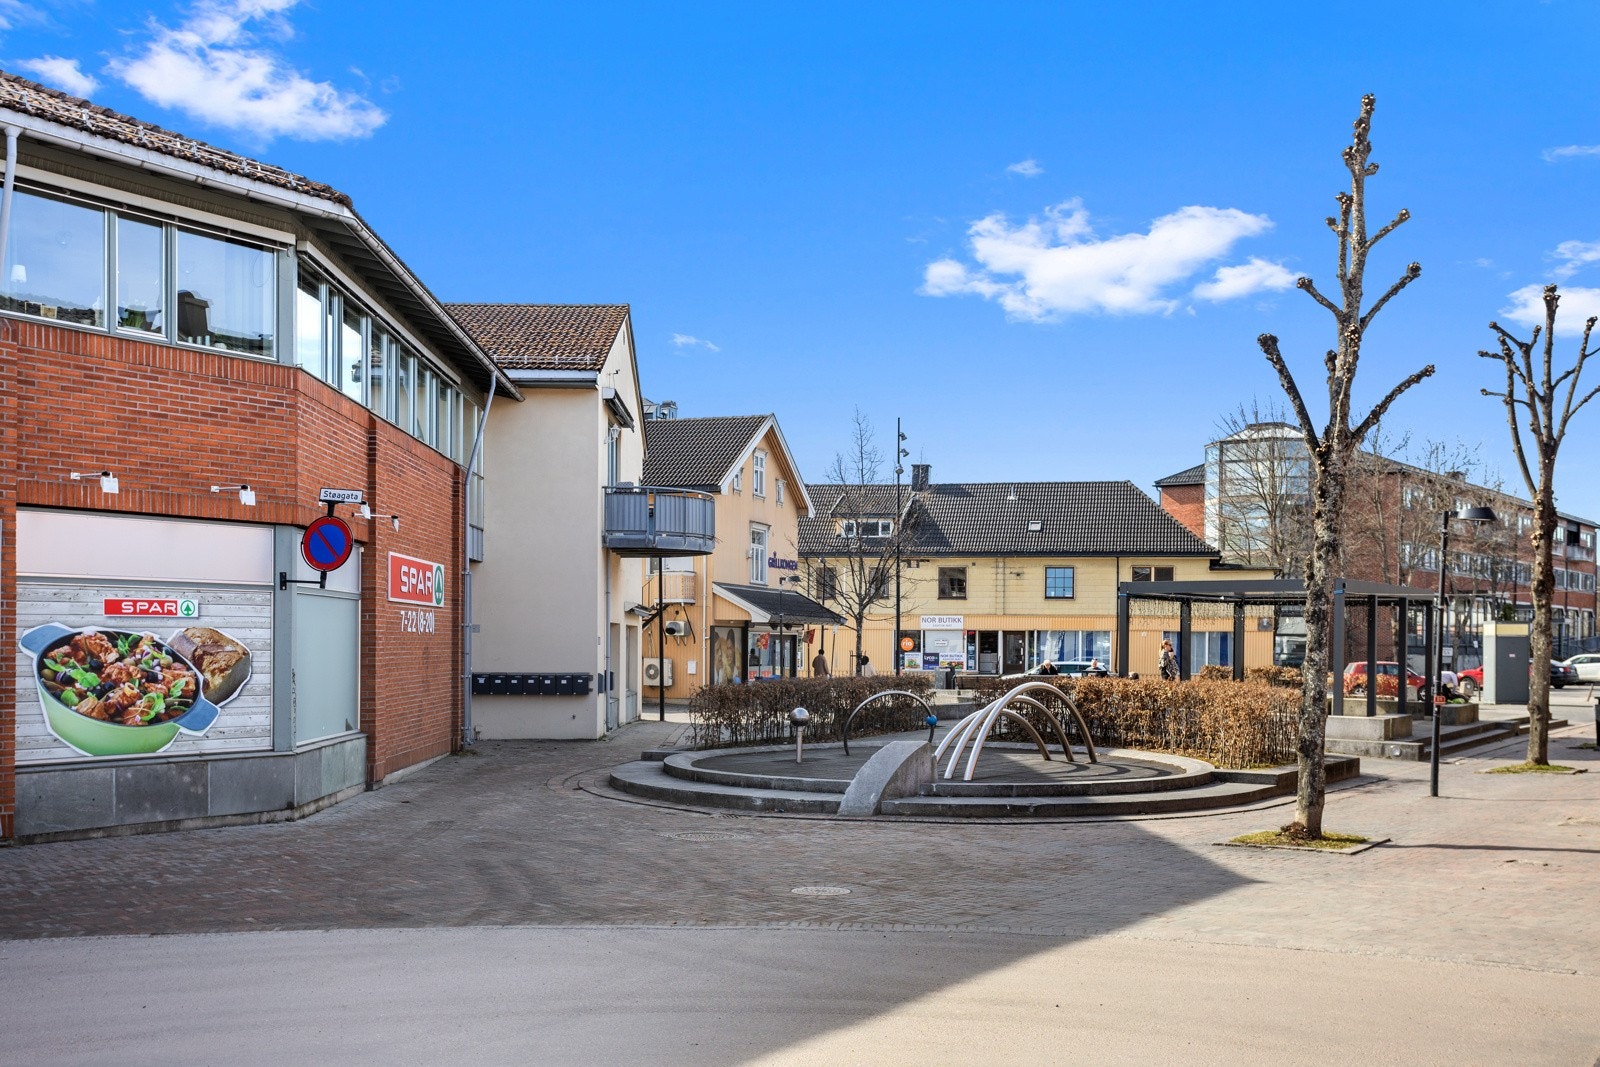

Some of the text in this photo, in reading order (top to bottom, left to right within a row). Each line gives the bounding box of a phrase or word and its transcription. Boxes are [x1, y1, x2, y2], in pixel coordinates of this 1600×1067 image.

[323, 490, 359, 500] Støagata
[400, 564, 433, 596] SPAR
[121, 601, 177, 614] SPAR
[400, 608, 435, 635] 7-22 (8-20)
